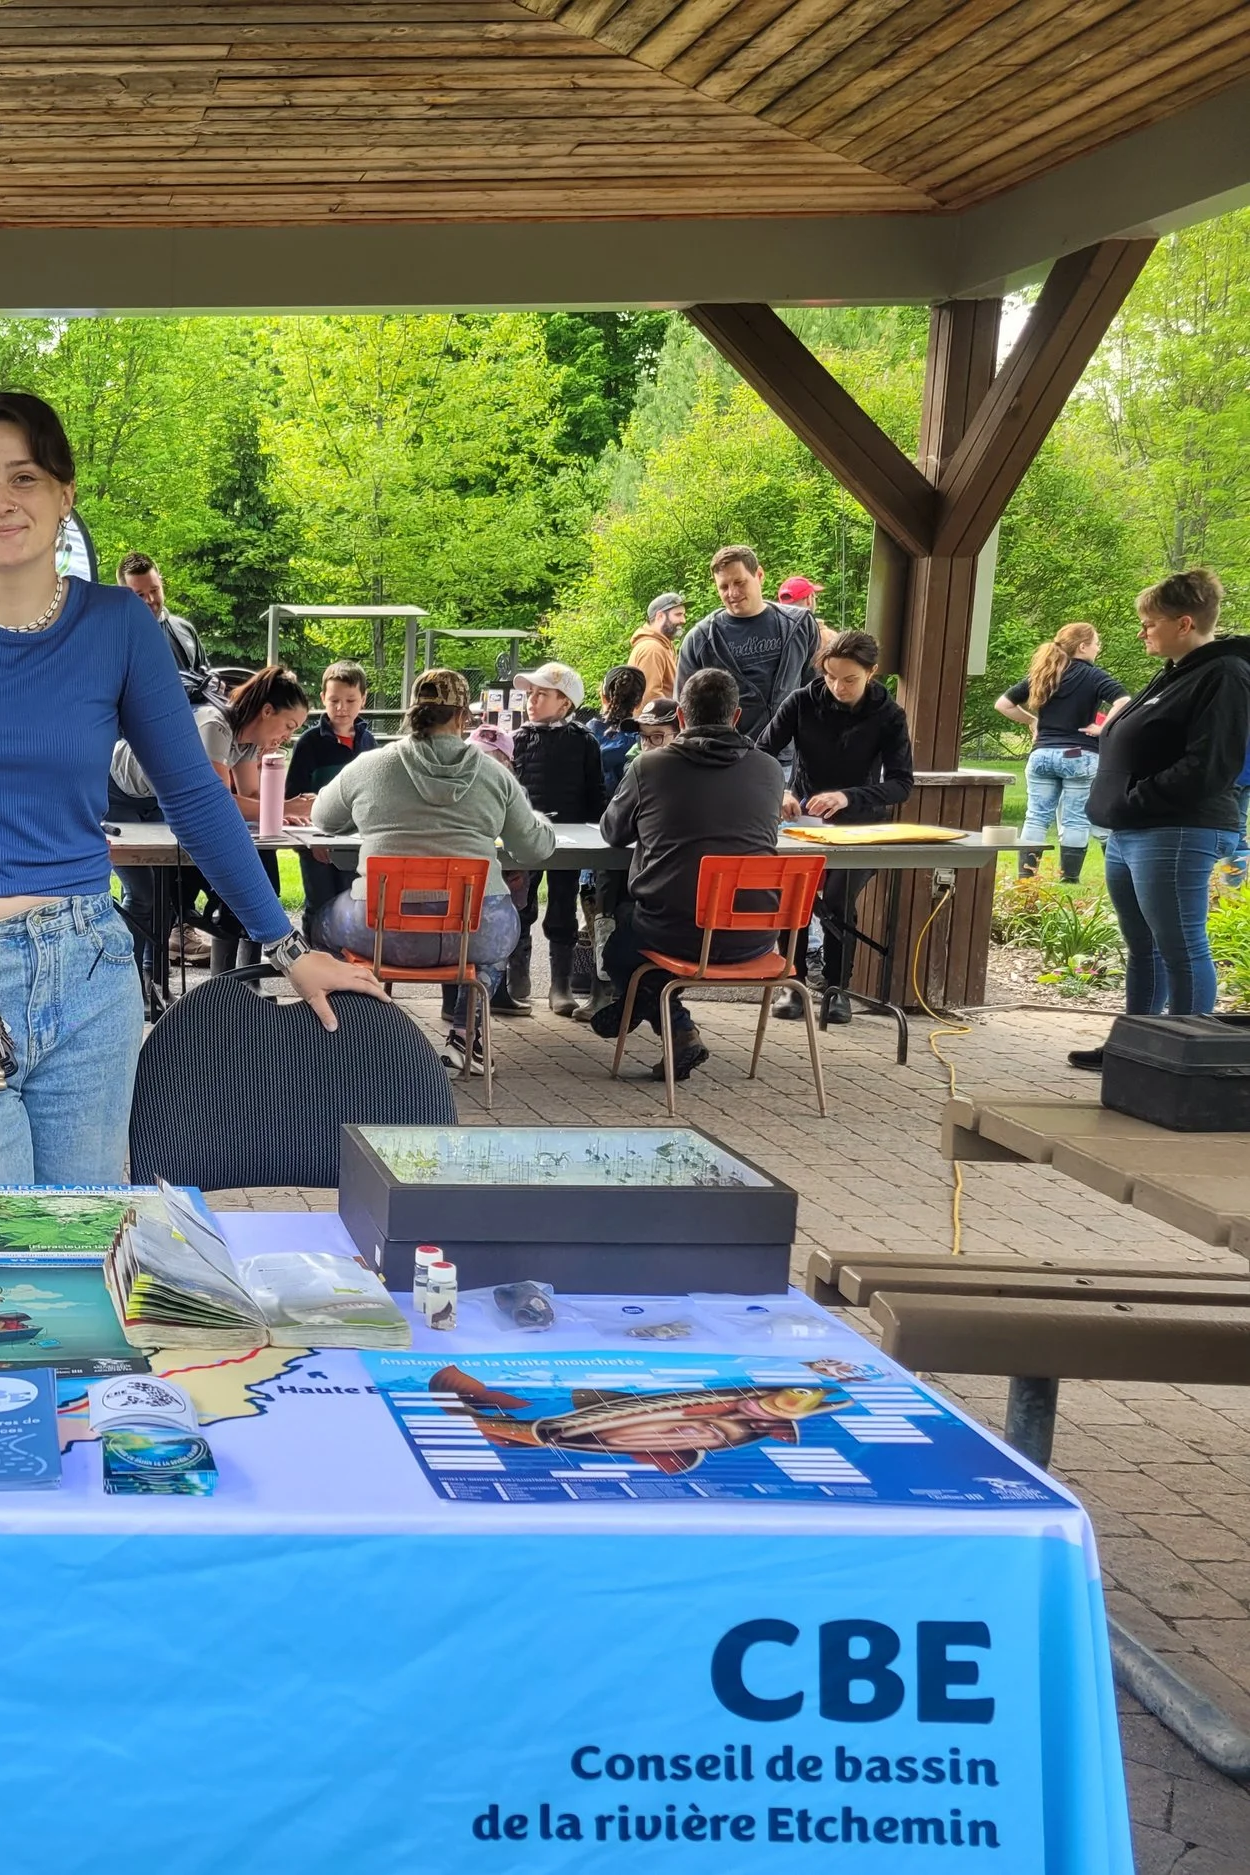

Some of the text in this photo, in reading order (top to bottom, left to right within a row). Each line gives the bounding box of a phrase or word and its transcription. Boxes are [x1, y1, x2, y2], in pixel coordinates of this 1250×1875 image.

[380, 1357, 645, 1367] Anatomie de la truite mouchetée
[277, 1385, 381, 1395] Haute E
[22, 1416, 41, 1424] de
[710, 1617, 996, 1725] CBE
[570, 1743, 1000, 1787] Conseil de bassin
[472, 1802, 1000, 1849] de la rivière Etchemin
